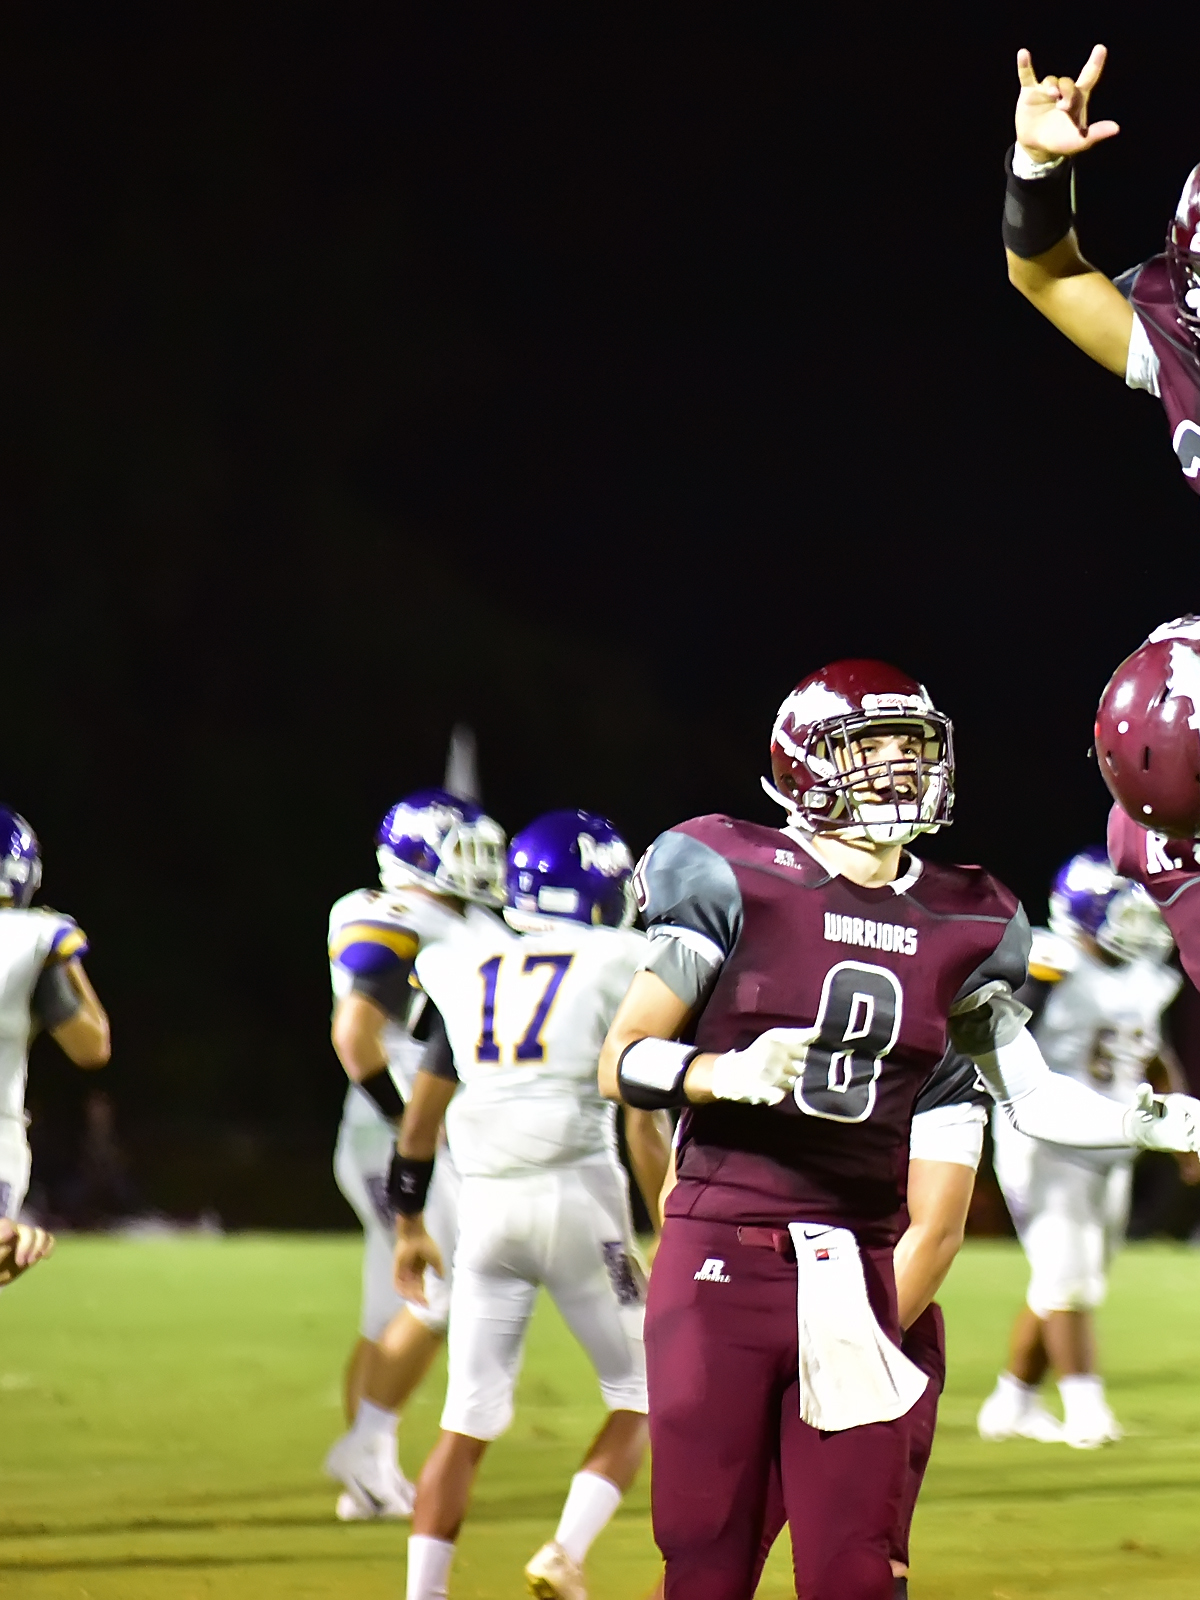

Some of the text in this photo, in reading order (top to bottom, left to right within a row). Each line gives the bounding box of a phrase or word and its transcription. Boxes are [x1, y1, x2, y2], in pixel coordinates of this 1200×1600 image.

[823, 911, 918, 956] WARRIORS
[475, 952, 576, 1065] 17
[793, 960, 903, 1123] 8
